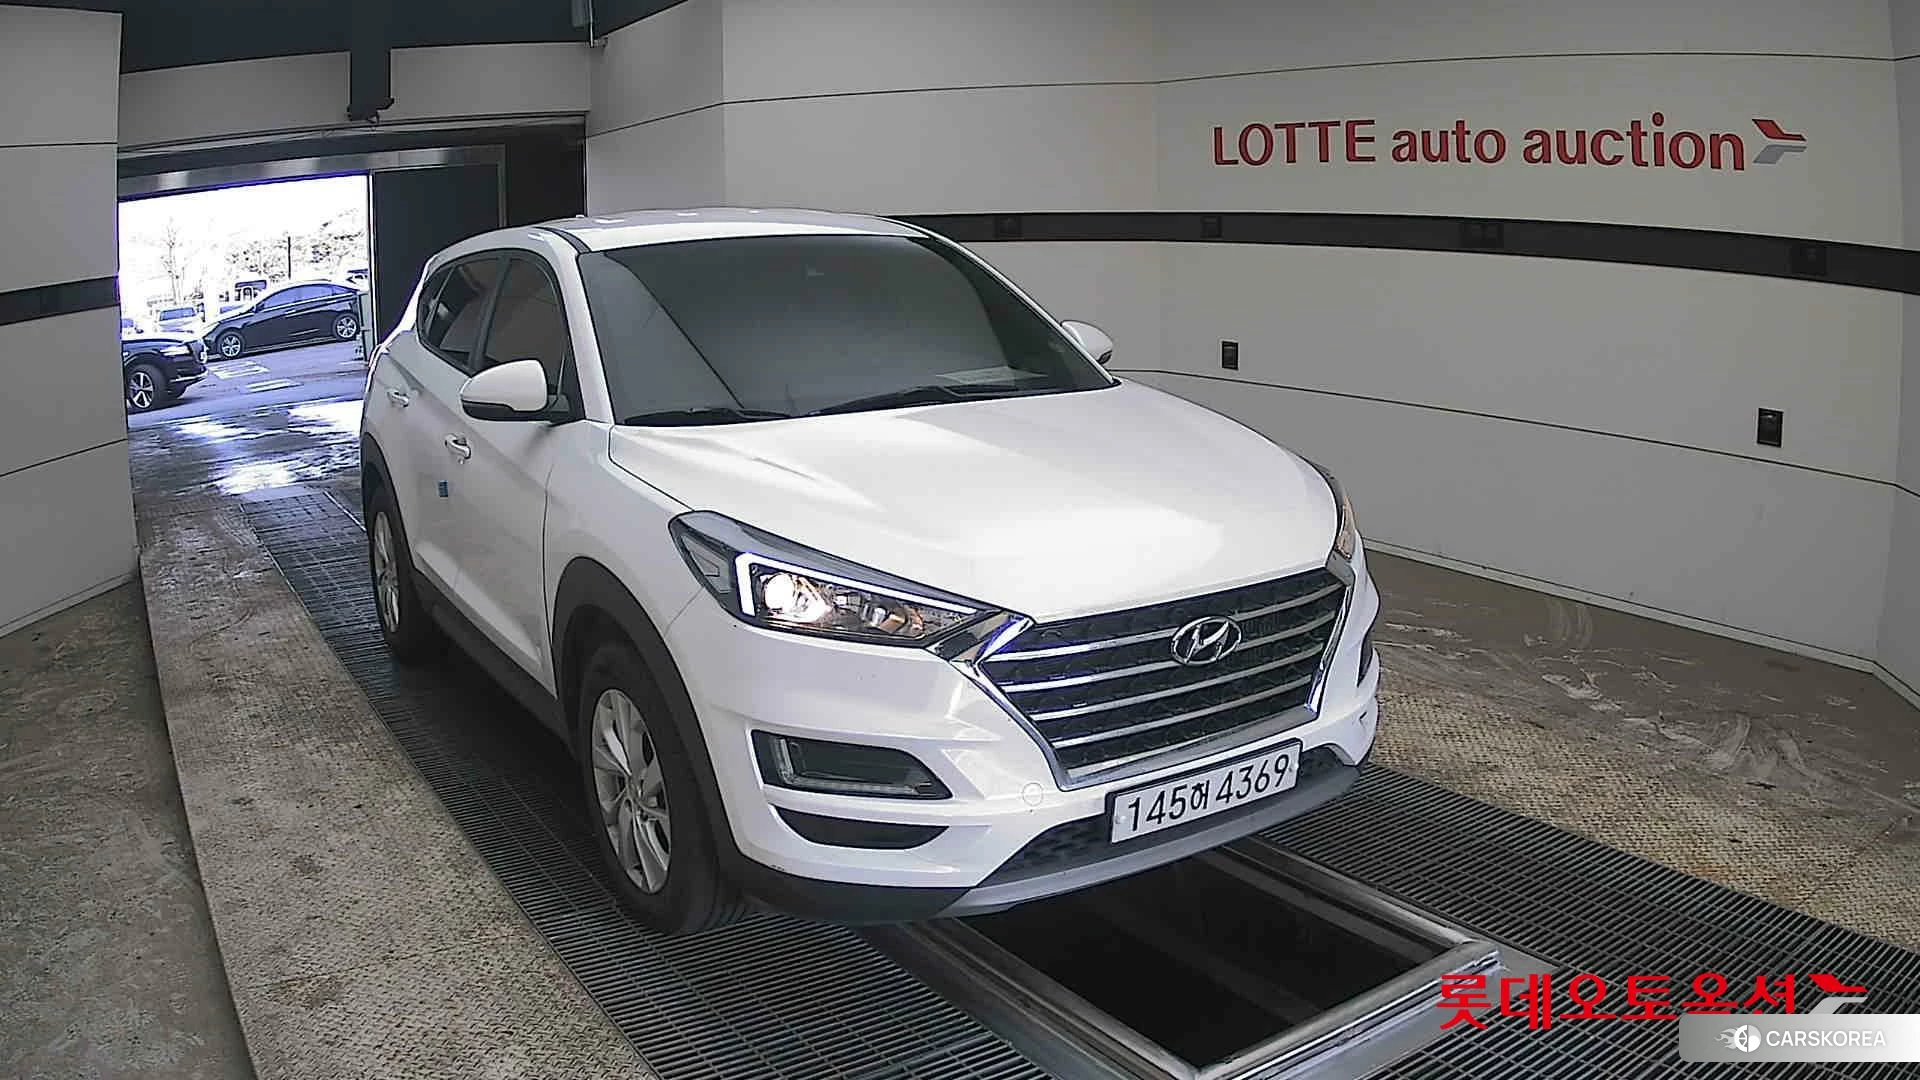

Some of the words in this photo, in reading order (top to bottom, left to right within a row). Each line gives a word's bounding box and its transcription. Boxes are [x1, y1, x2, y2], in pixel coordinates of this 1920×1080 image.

[1212, 119, 1376, 166] LOTTE
[1391, 120, 1507, 165] auto
[1522, 112, 1745, 171] auction
